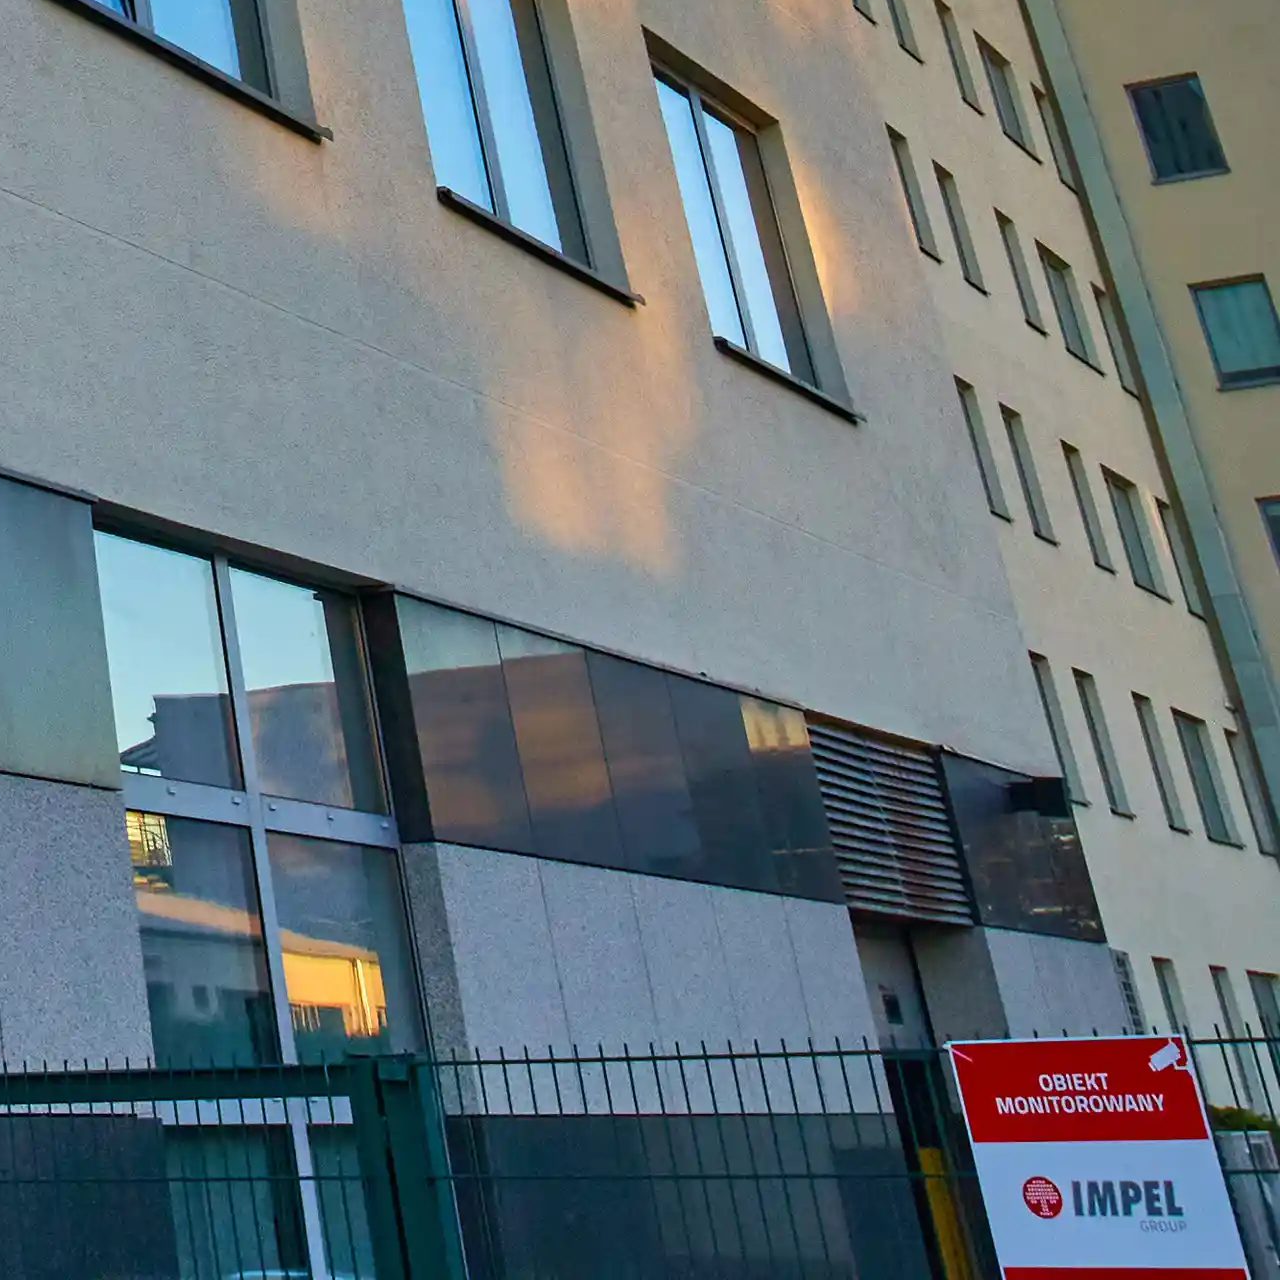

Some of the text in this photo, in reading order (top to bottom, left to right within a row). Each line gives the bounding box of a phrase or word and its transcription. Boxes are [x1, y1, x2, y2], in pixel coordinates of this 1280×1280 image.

[1038, 1072, 1108, 1092] OBIEKT
[995, 1093, 1165, 1115] MONITOROWANY
[1071, 1179, 1184, 1217] IMPEL
[1140, 1220, 1187, 1233] GROUP
